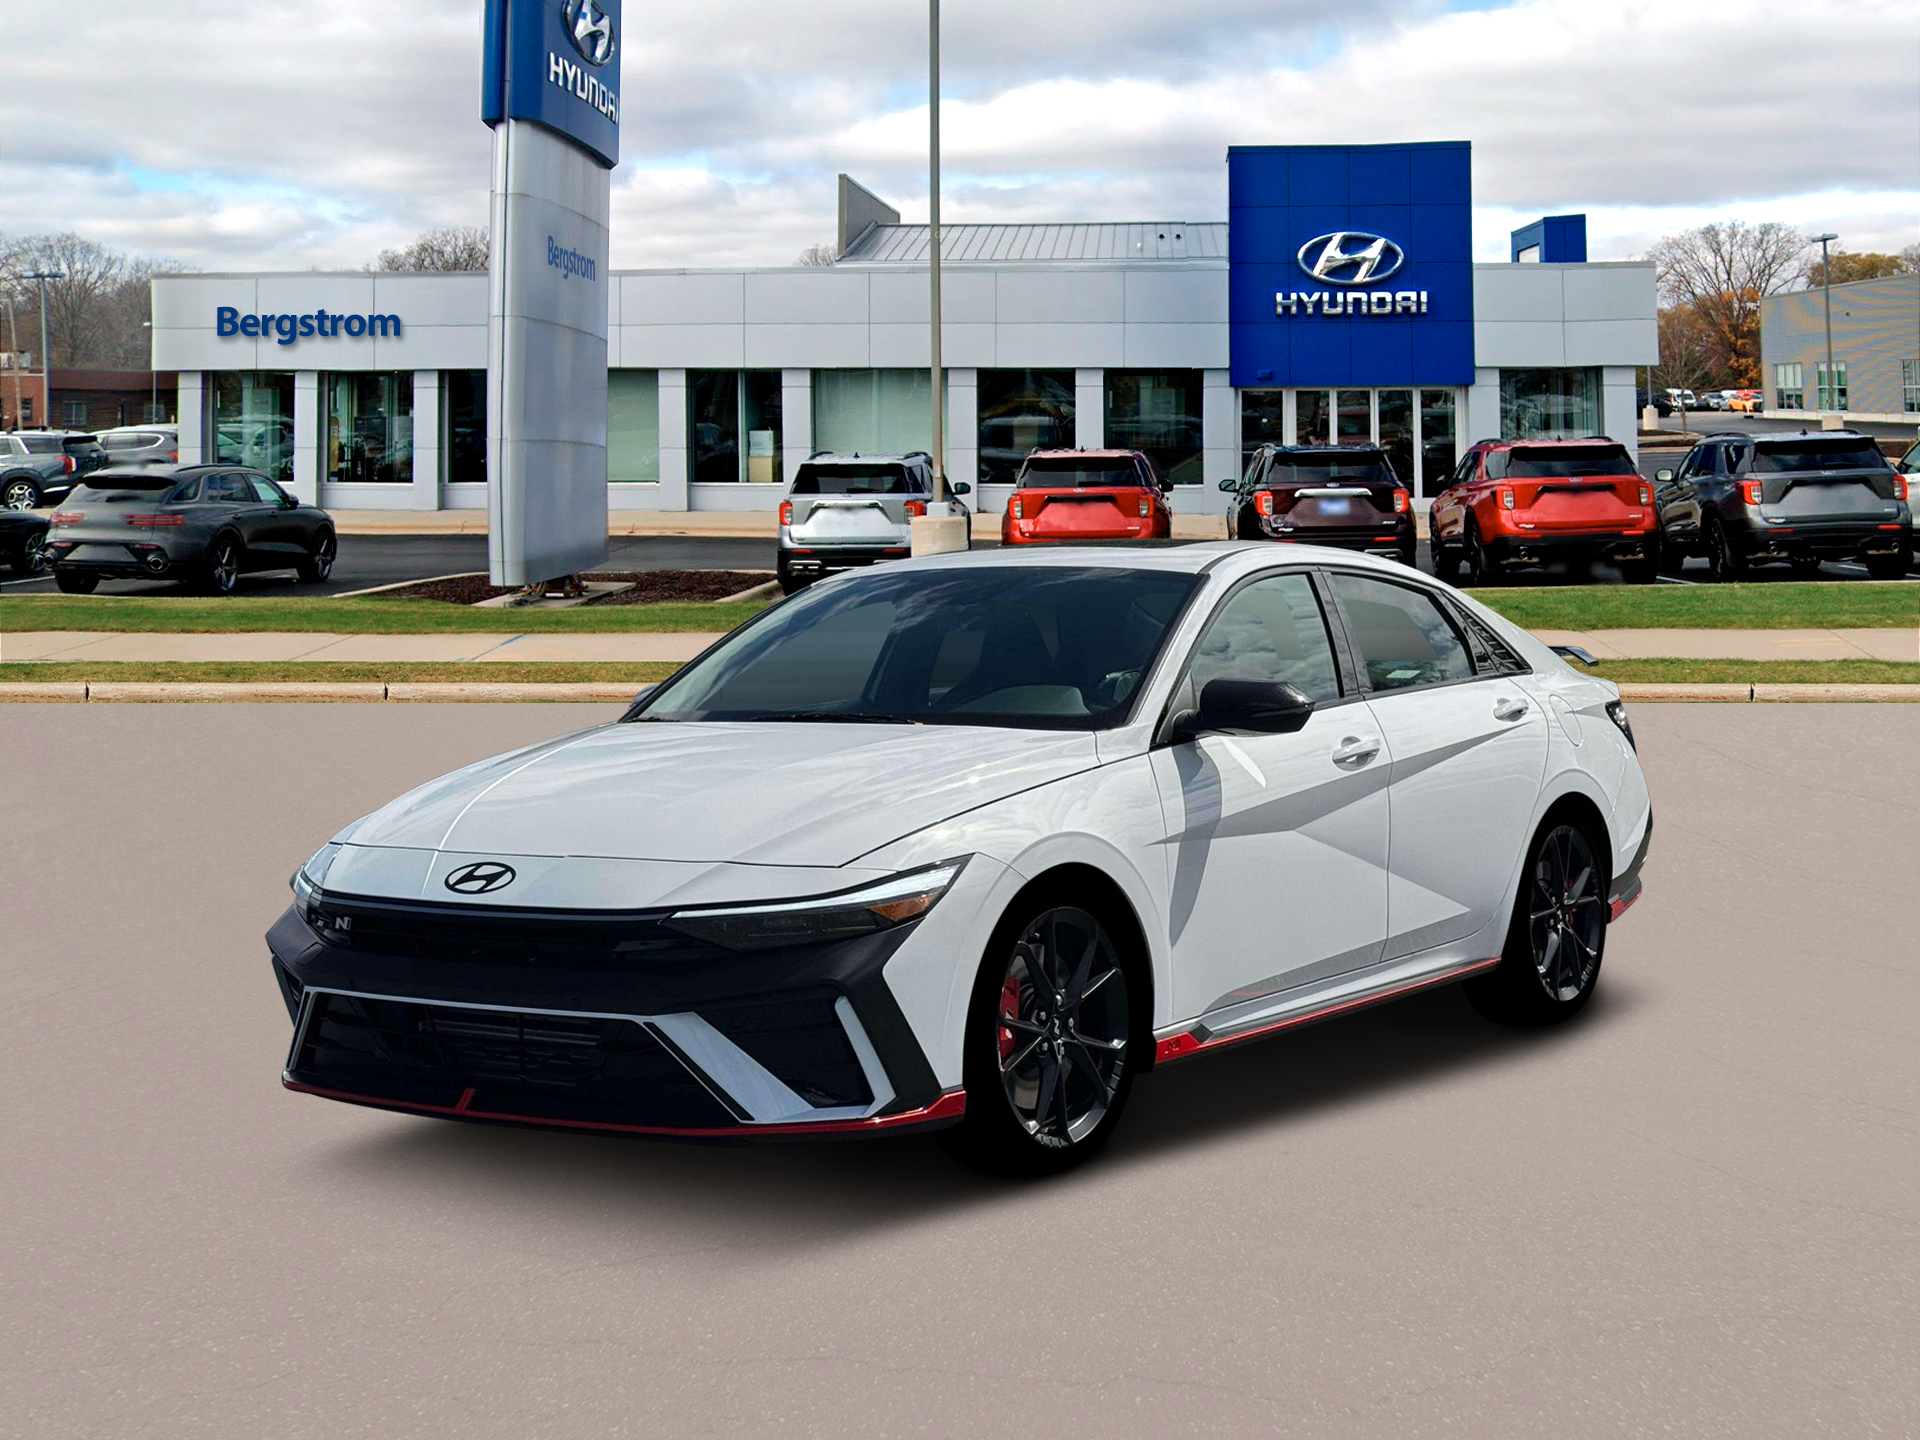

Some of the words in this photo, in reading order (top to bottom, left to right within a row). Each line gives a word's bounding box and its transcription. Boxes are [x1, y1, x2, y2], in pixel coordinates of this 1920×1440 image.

[549, 52, 619, 124] HYUNDAI
[547, 235, 596, 282] Bergstrom
[1275, 291, 1428, 315] HYUNDAI
[216, 306, 401, 346] Bergstrom
